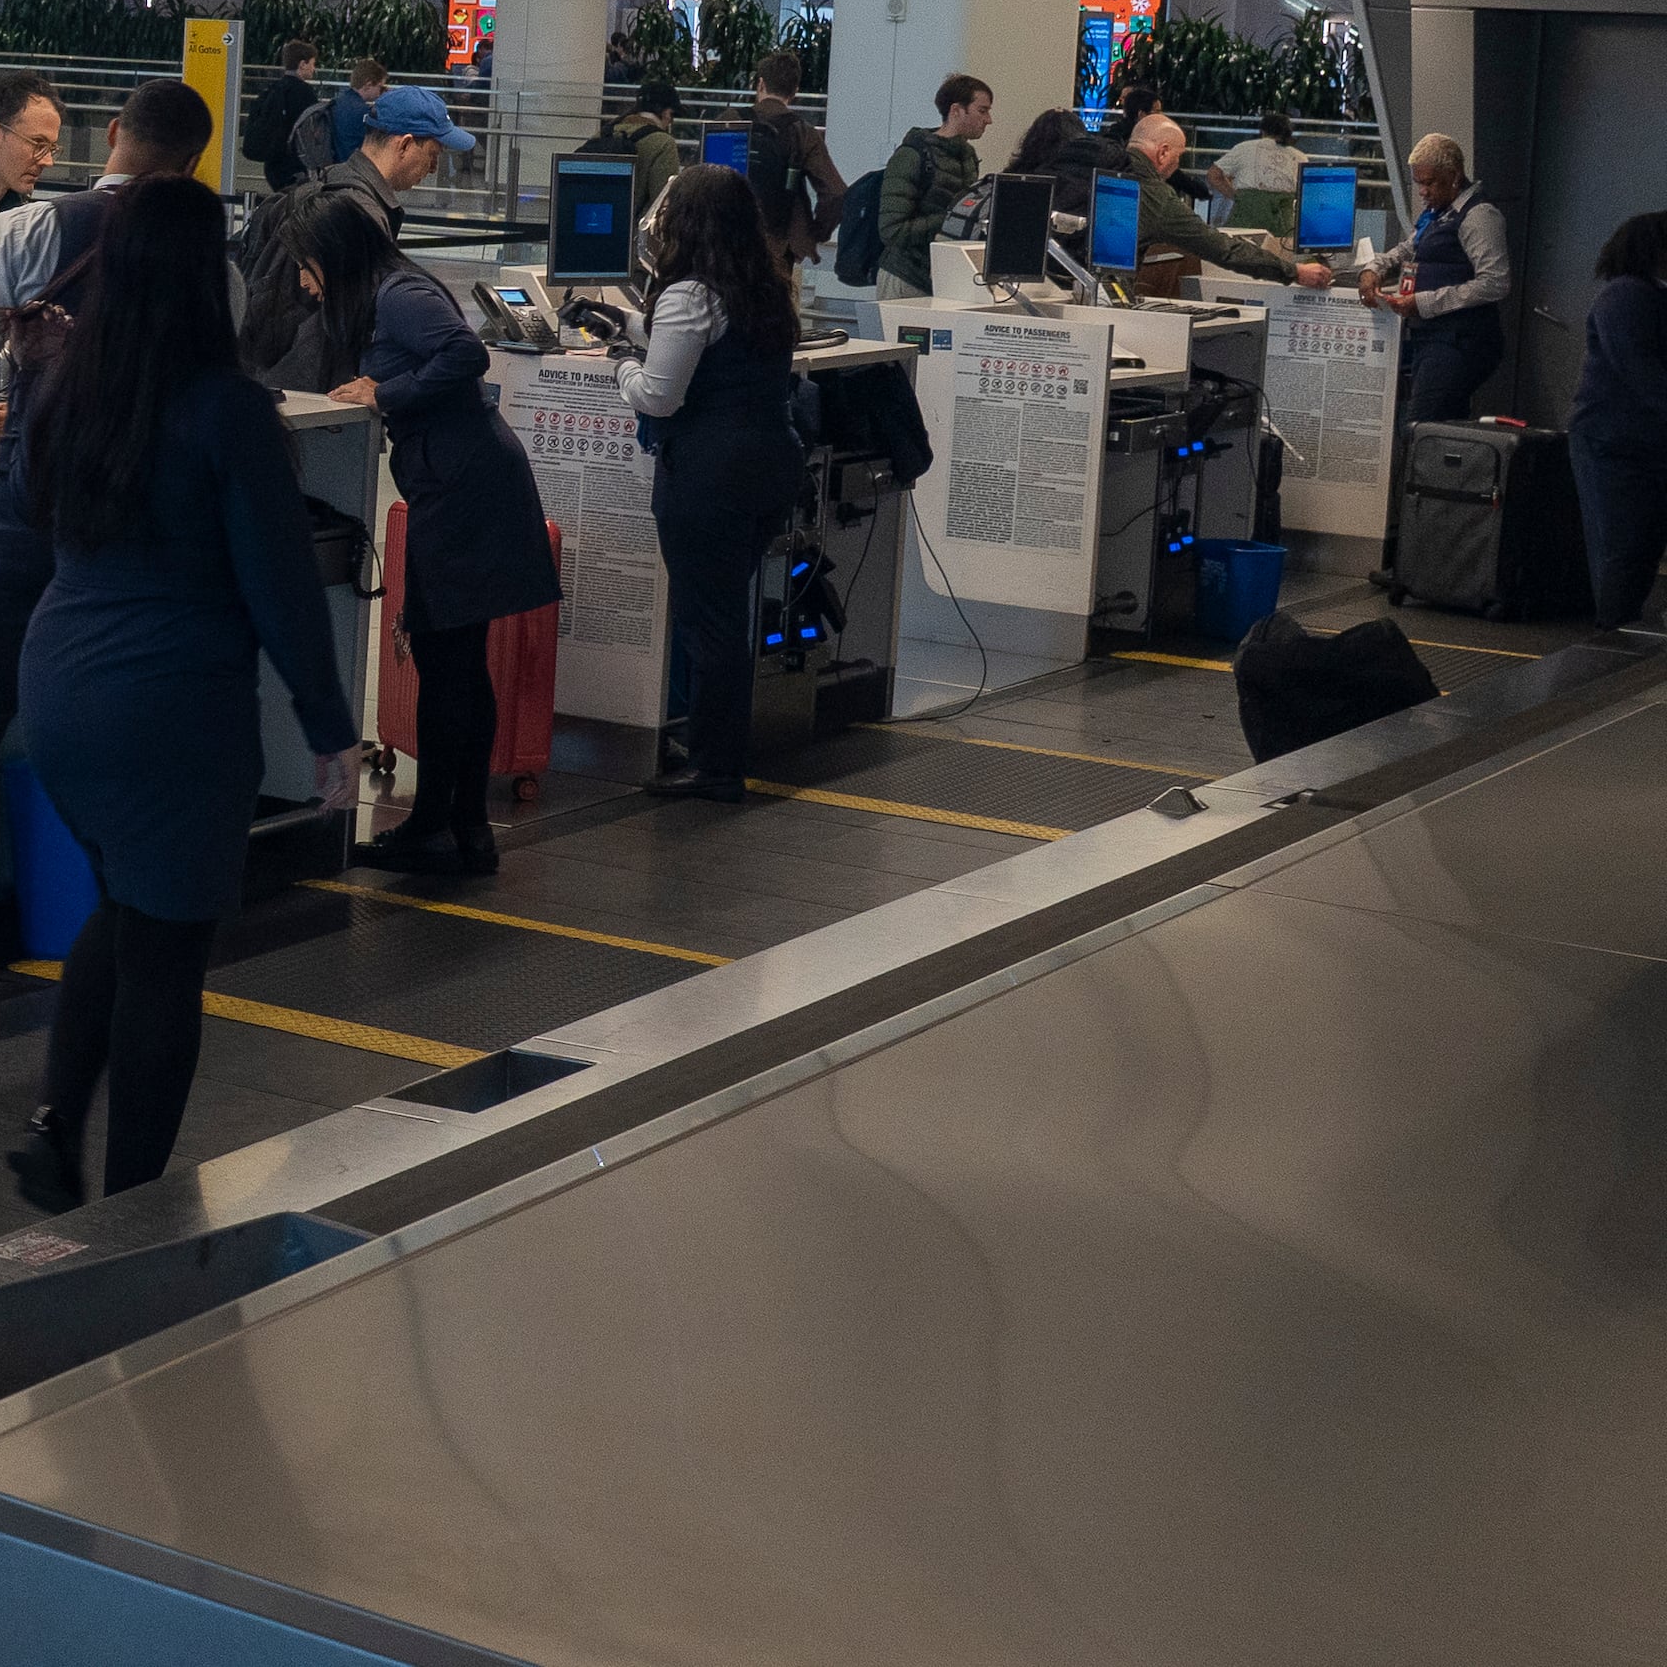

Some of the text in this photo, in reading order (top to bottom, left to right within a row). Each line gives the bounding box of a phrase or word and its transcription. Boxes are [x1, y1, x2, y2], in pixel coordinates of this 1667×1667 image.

[189, 45, 221, 54] All Gates
[984, 324, 1070, 339] ADVICE TO PASSENGERS
[539, 369, 618, 385] ADVICE TO PASSEN
